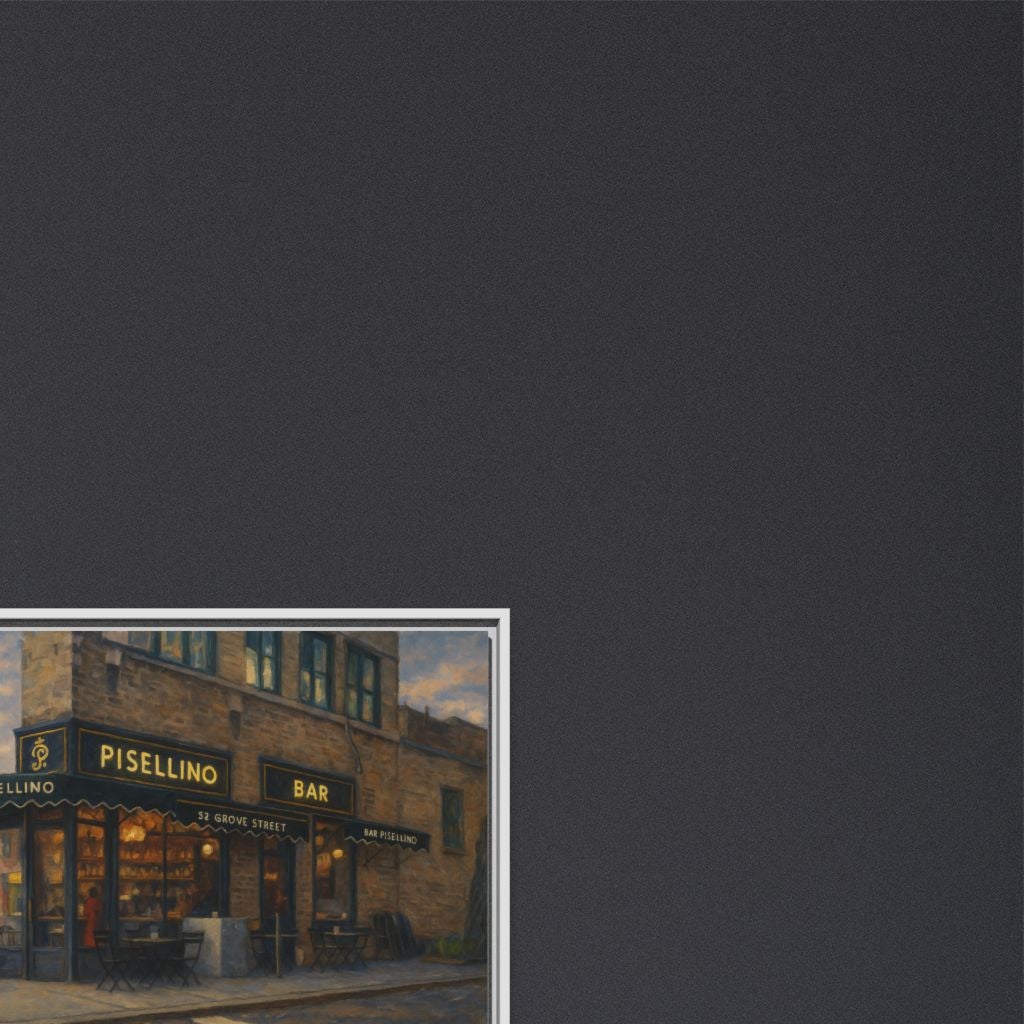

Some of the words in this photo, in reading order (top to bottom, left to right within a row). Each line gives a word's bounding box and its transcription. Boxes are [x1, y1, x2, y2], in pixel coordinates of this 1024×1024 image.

[100, 744, 218, 785] PISELLINO
[293, 779, 329, 802] BAR
[214, 813, 248, 827] GROVE
[252, 818, 287, 832] STREET
[364, 828, 378, 838] BAR
[380, 830, 418, 845] PISELLINO
